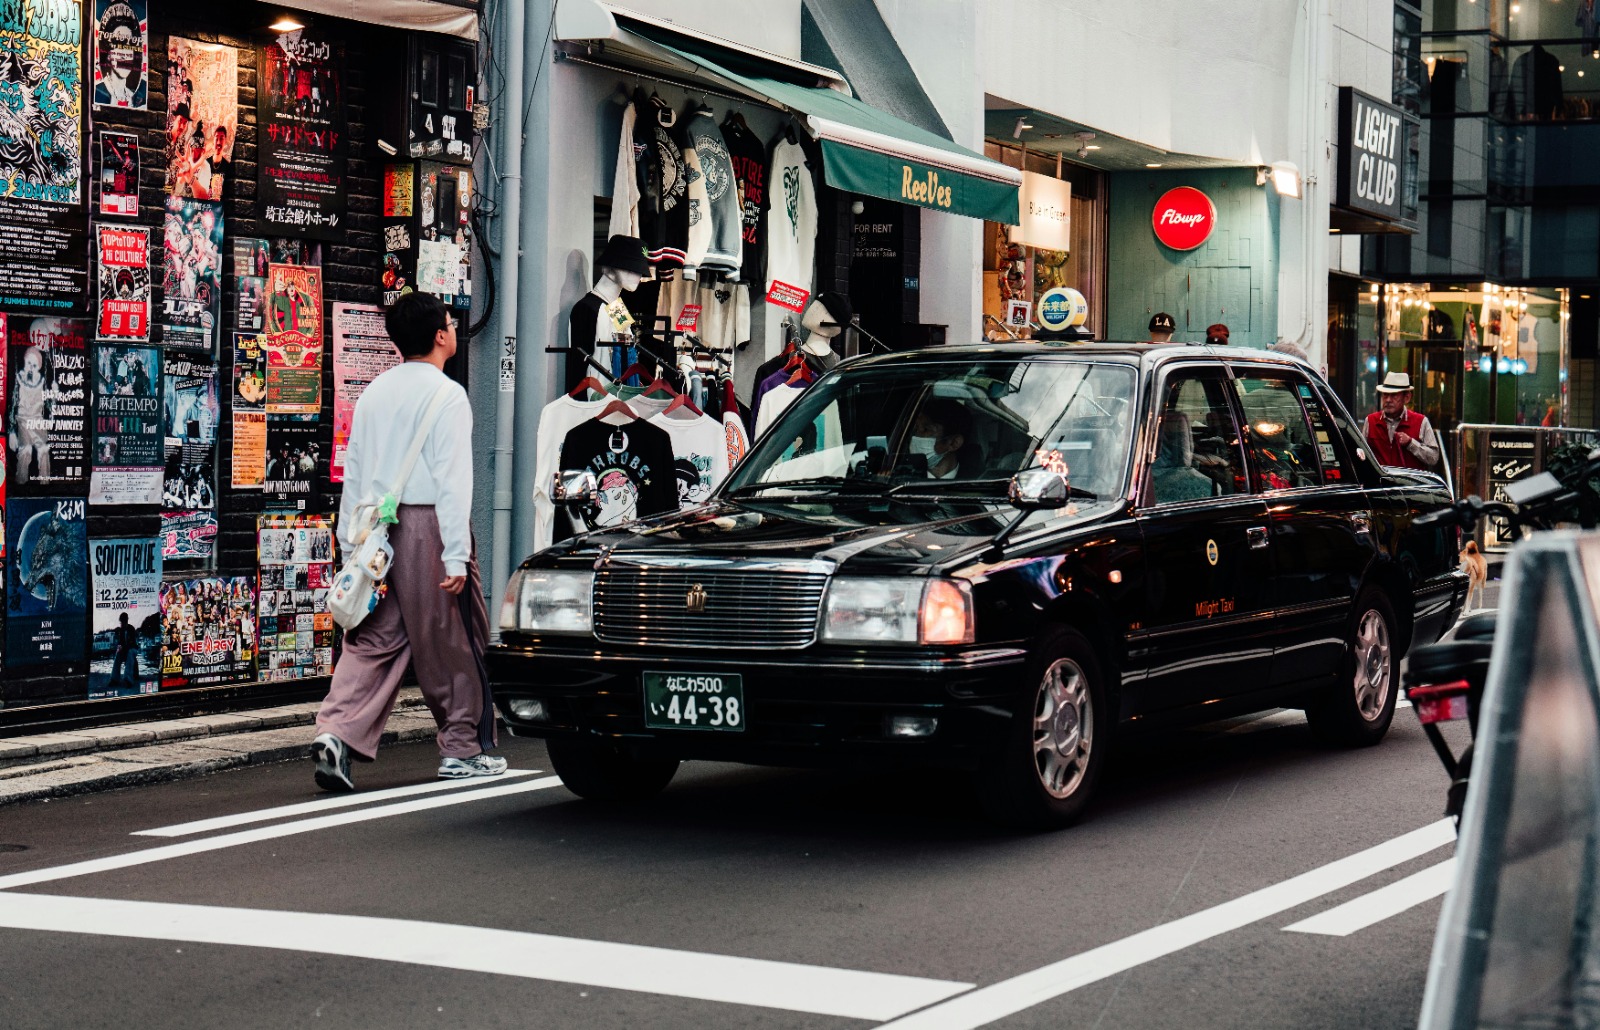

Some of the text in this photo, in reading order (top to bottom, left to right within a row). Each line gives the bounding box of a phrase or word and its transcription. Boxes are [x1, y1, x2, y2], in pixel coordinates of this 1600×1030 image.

[267, 124, 339, 150] サリドマイド
[1354, 102, 1400, 159] LIGHT
[1357, 152, 1397, 206] CLUB
[265, 205, 339, 227] 埼玉会館小ホール
[854, 223, 893, 234] FOR RENT
[105, 249, 144, 263] Hi CULTURE
[4, 297, 29, 305] SUMMER
[107, 301, 129, 312] FOLLOW
[53, 353, 85, 370] BALZAC
[234, 413, 265, 423] TIME TABLE
[142, 422, 158, 434] Tour
[95, 542, 155, 576] SOUTH BLUE
[100, 588, 128, 601] 12.22
[1220, 597, 1235, 613] Taxi
[163, 654, 182, 668] 11.09
[650, 694, 740, 727] い 44-38
